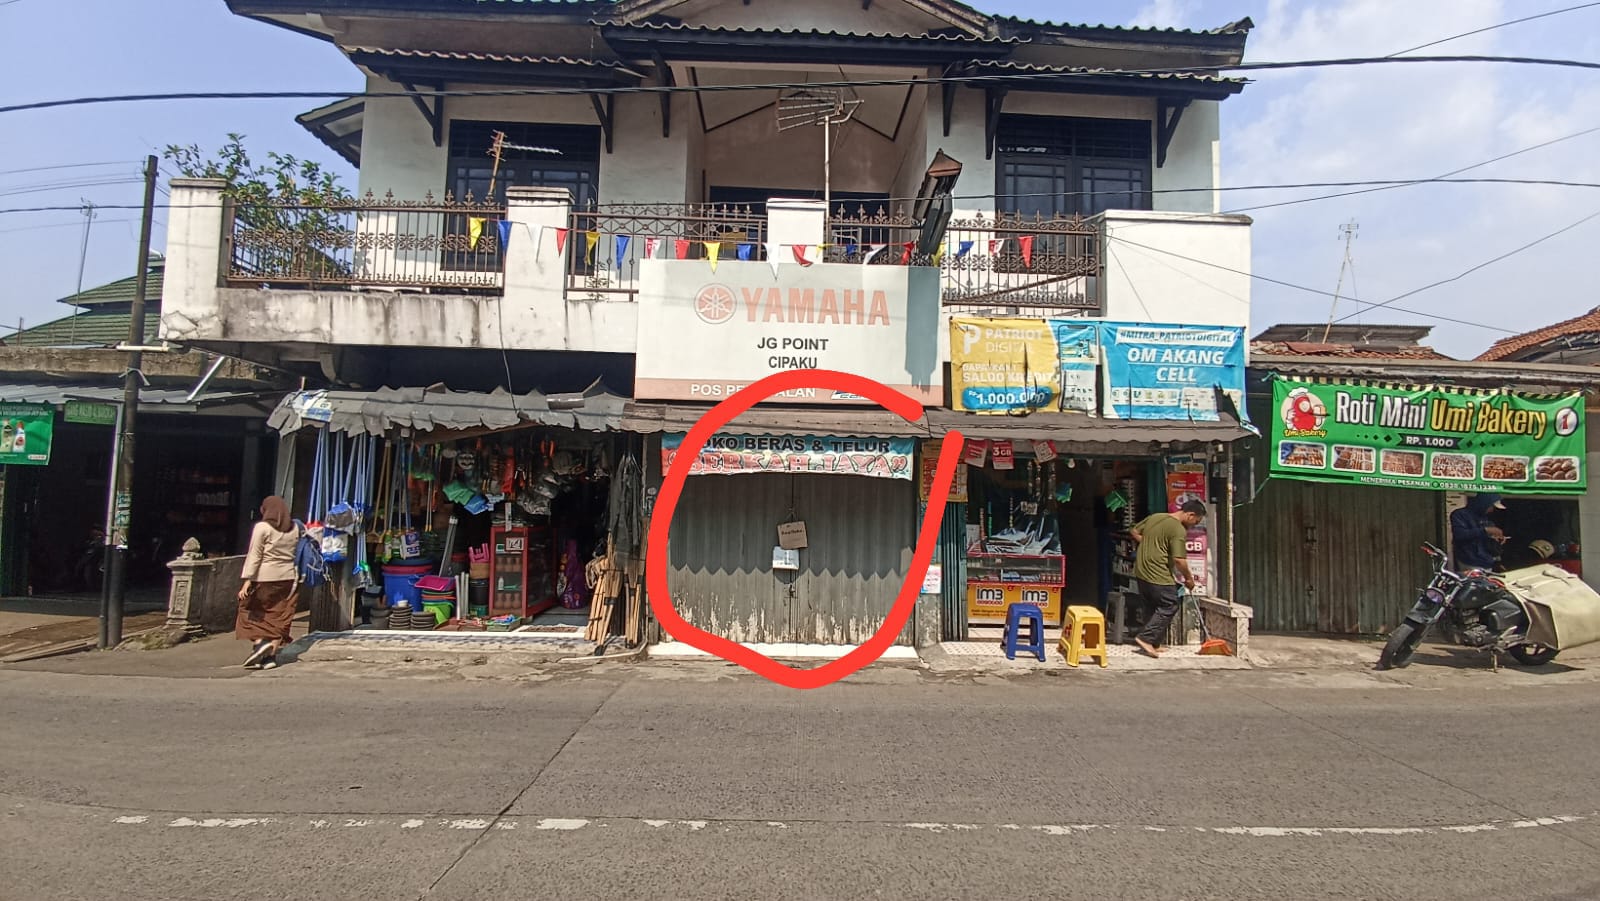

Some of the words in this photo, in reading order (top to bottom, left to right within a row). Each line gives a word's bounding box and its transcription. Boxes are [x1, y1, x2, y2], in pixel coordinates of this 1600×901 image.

[741, 287, 890, 326] YAMAHA
[985, 329, 1043, 341] PATRIOT
[757, 337, 778, 349] JG
[782, 338, 829, 350] POINT
[768, 356, 817, 369] CIPAKU
[1128, 347, 1157, 362] OM
[1161, 349, 1225, 365] AKANG
[963, 372, 1005, 383] SALDO
[1156, 367, 1197, 381] CELL
[691, 384, 722, 396] POS
[726, 385, 816, 398] PEALAN
[1335, 391, 1376, 426] Roti
[1379, 395, 1427, 430] Mini
[1431, 398, 1475, 433] Umi
[1475, 402, 1547, 440] Bakery
[1560, 413, 1569, 431] 1
[744, 438, 805, 451] BERAS
[812, 439, 824, 452] &
[830, 440, 890, 453] TELUR
[1405, 435, 1422, 446] RP.
[1425, 437, 1454, 448] 1.000
